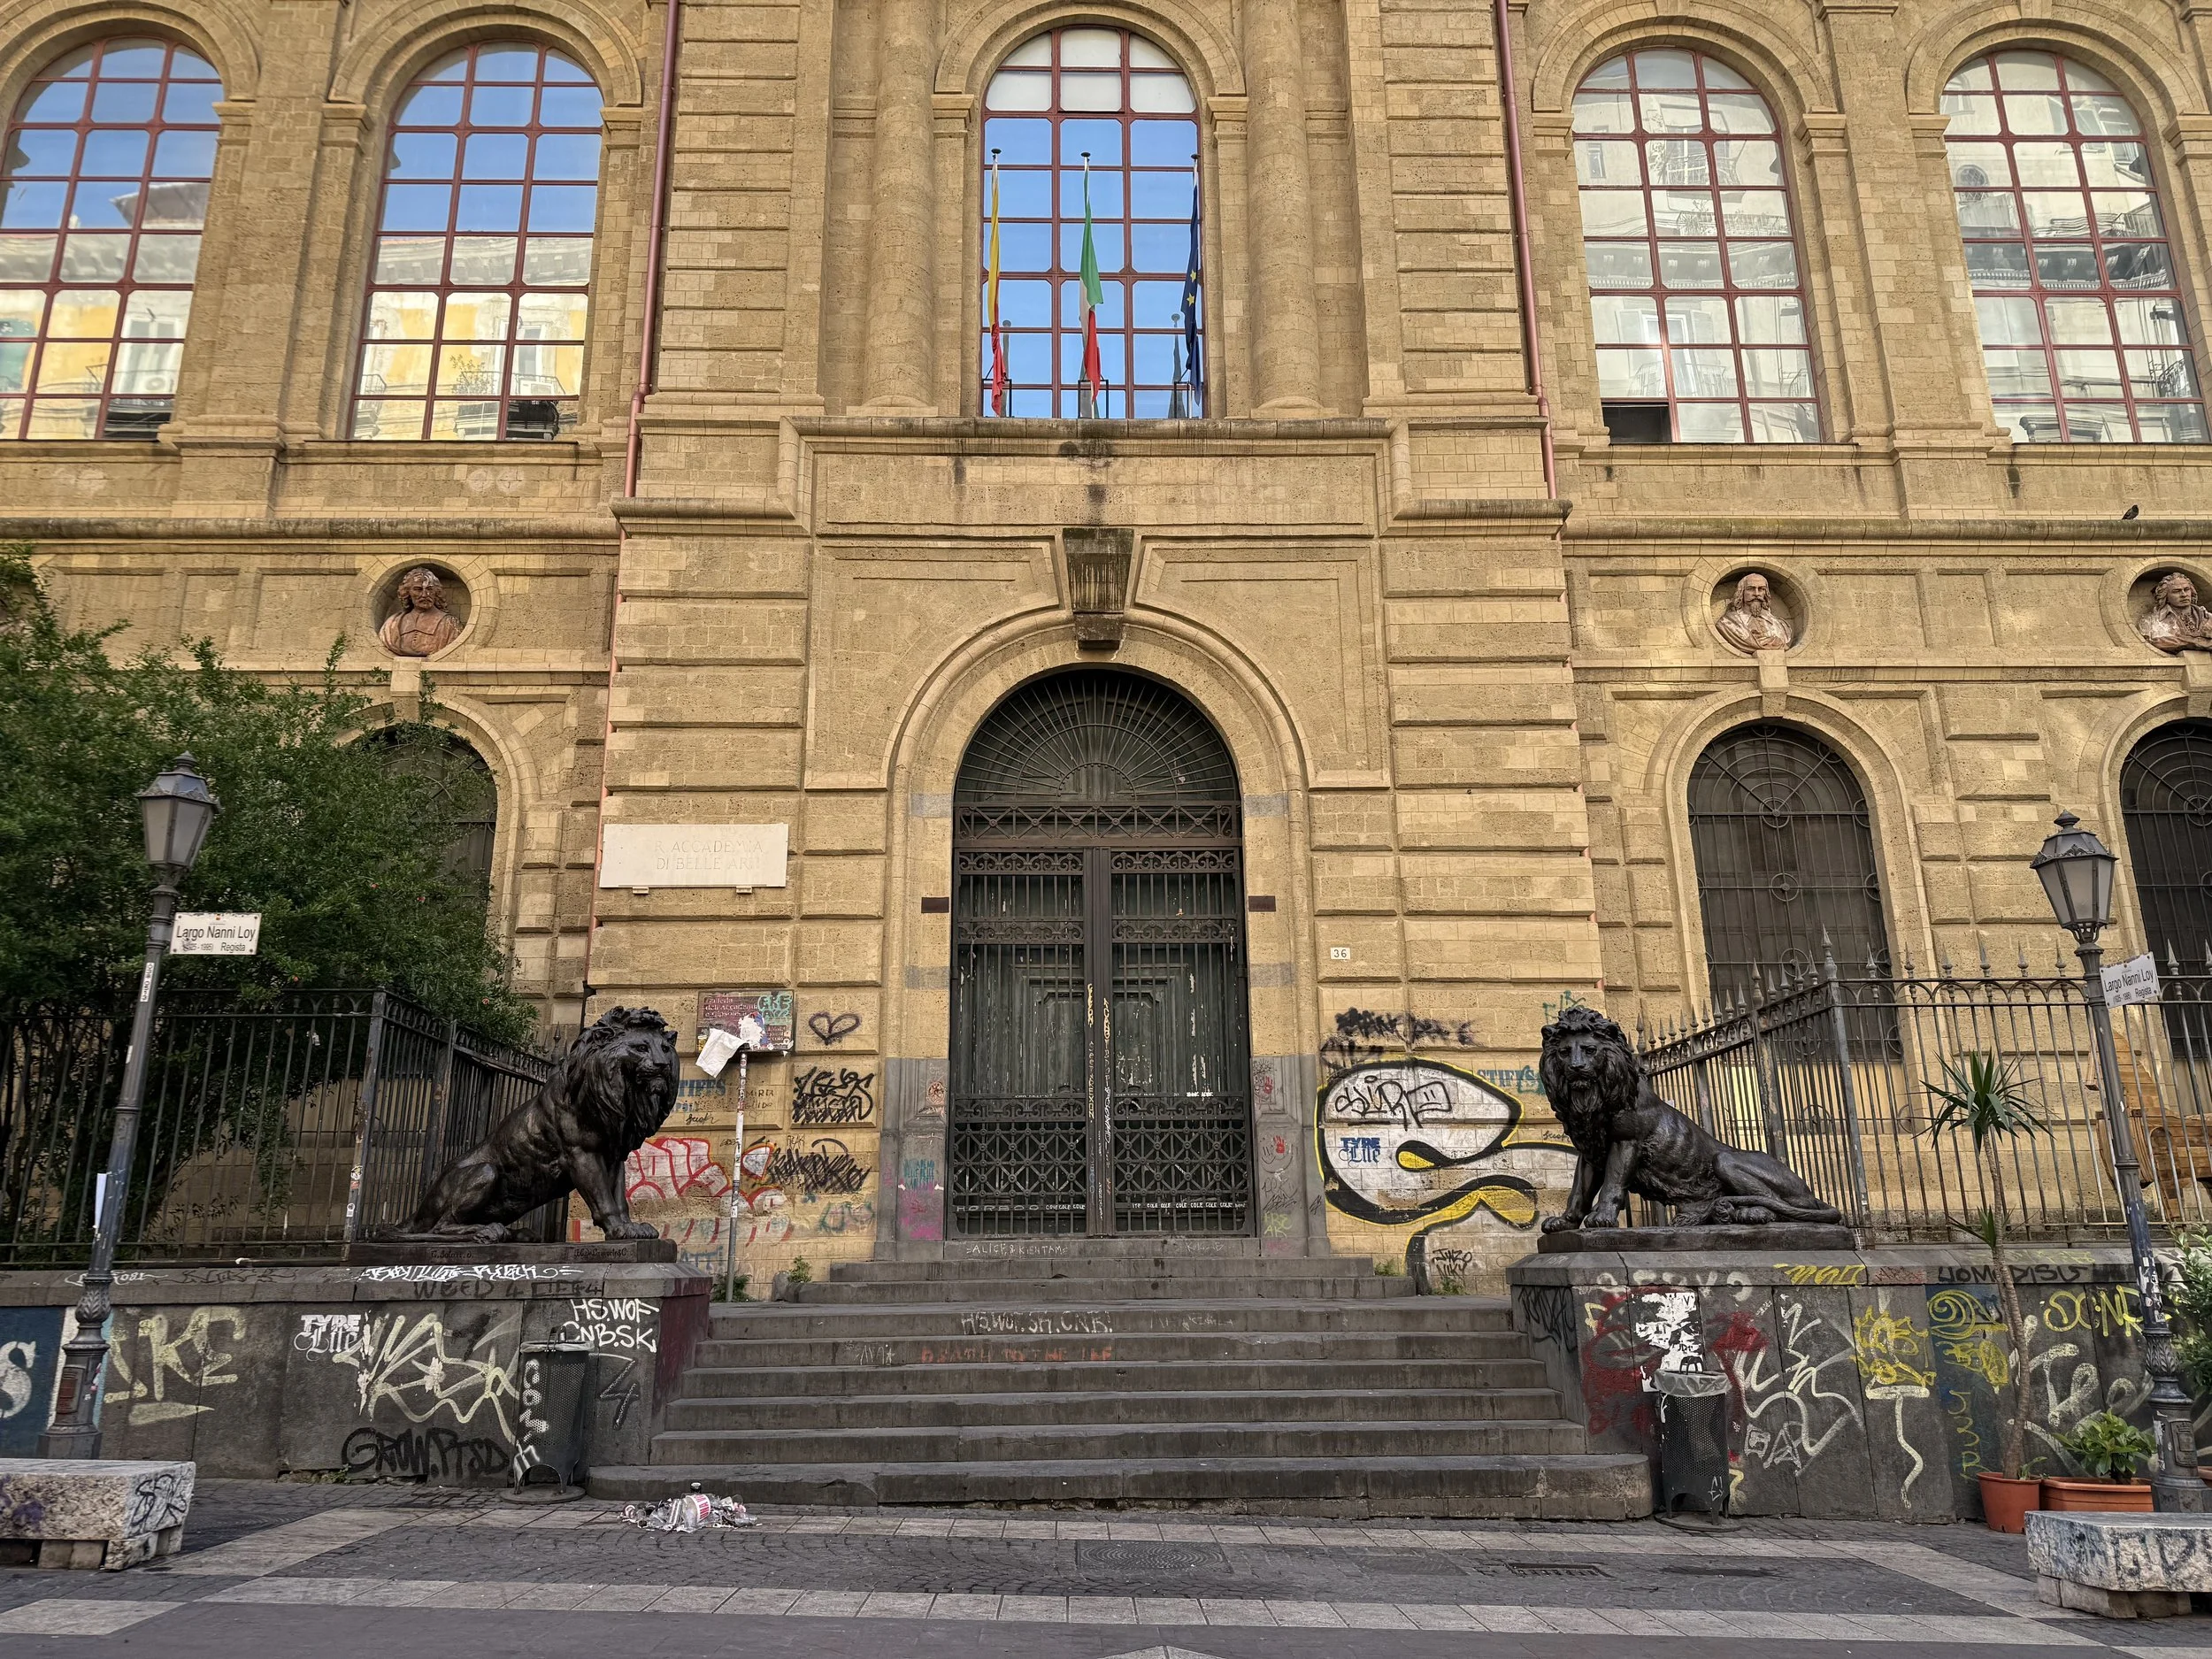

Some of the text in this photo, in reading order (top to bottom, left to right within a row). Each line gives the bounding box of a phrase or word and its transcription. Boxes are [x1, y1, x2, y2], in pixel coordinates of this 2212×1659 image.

[676, 857, 721, 870] BELLE
[177, 926, 256, 942] Largo Nanni Loy
[220, 942, 246, 953] Regista
[1333, 949, 1347, 959] 36
[2104, 969, 2154, 993] Largo Nanni Loy
[2135, 987, 2152, 998] Regista
